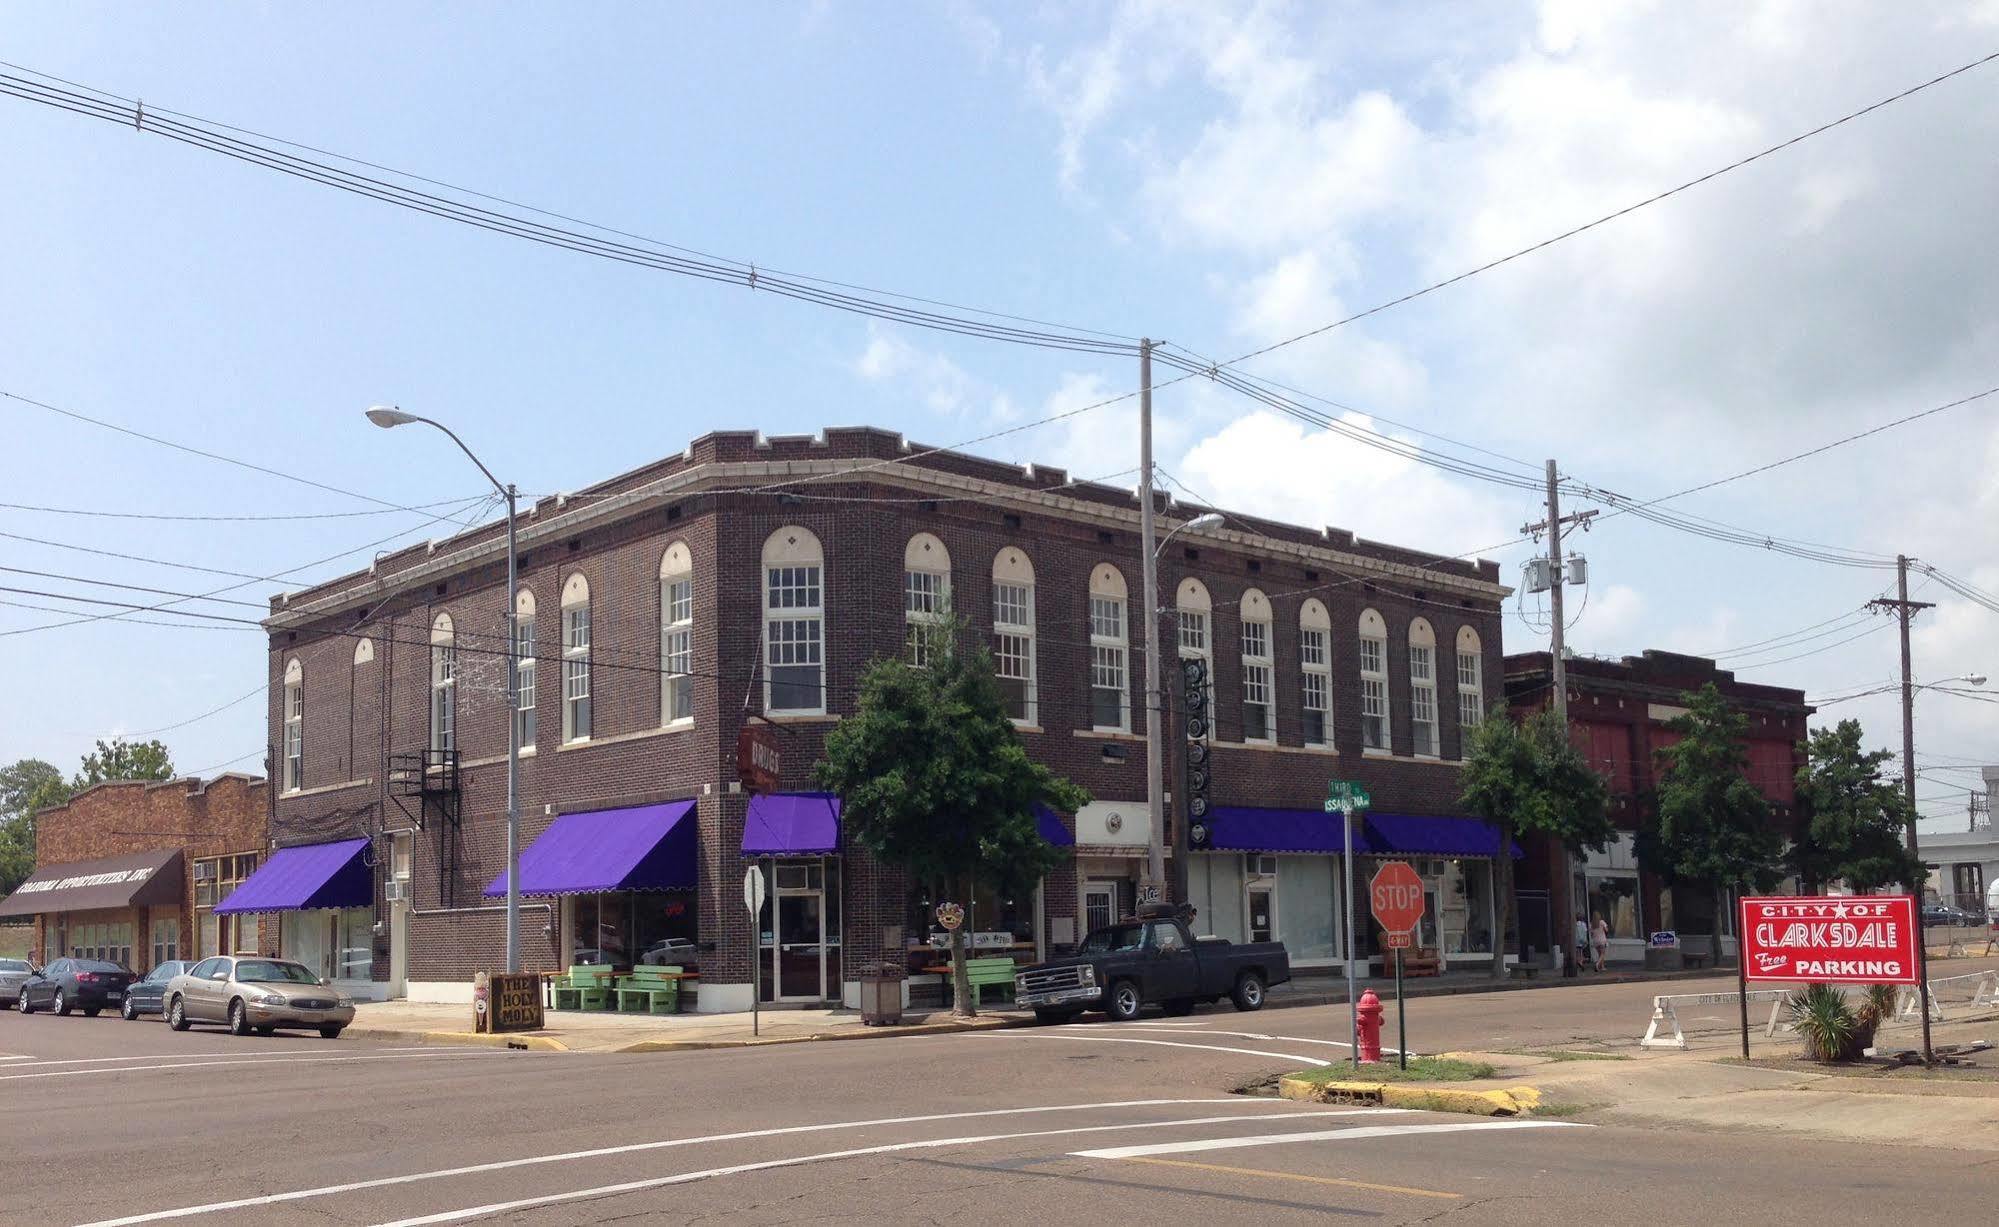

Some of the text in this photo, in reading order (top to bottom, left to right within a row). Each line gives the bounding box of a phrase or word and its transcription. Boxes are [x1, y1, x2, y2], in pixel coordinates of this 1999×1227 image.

[752, 740, 780, 774] DRUGS
[1324, 796, 1364, 812] ISSAQNA
[1375, 884, 1420, 911] STOP
[1755, 922, 1898, 948] CLARKSDALE
[1754, 952, 1788, 966] Free
[1796, 960, 1900, 975] PARKING
[504, 978, 529, 991] THE
[502, 992, 534, 1007] HOLY
[502, 1007, 537, 1023] MOLY
